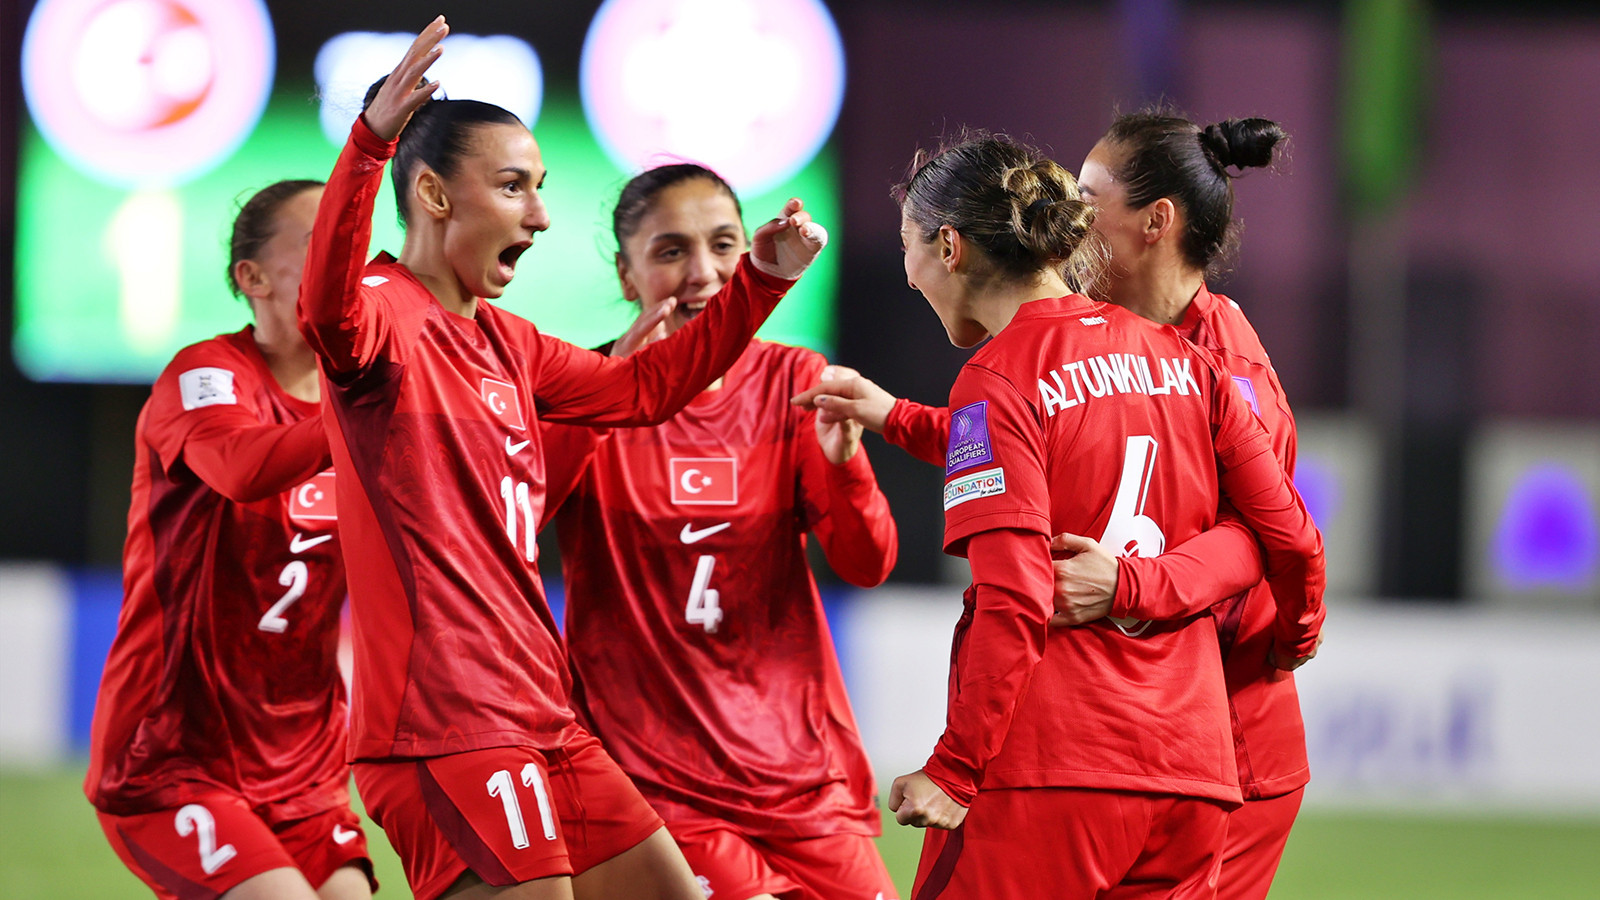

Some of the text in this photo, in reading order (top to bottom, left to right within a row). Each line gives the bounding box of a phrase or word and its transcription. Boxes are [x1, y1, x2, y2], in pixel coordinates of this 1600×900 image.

[948, 448, 987, 467] QUALIFIERS
[949, 441, 985, 460] EUROPEAN
[500, 475, 537, 563] 11
[1099, 435, 1167, 637] 6
[257, 560, 308, 633] 2
[685, 554, 723, 633] 4
[174, 803, 238, 875] 2
[486, 762, 557, 850] 11
